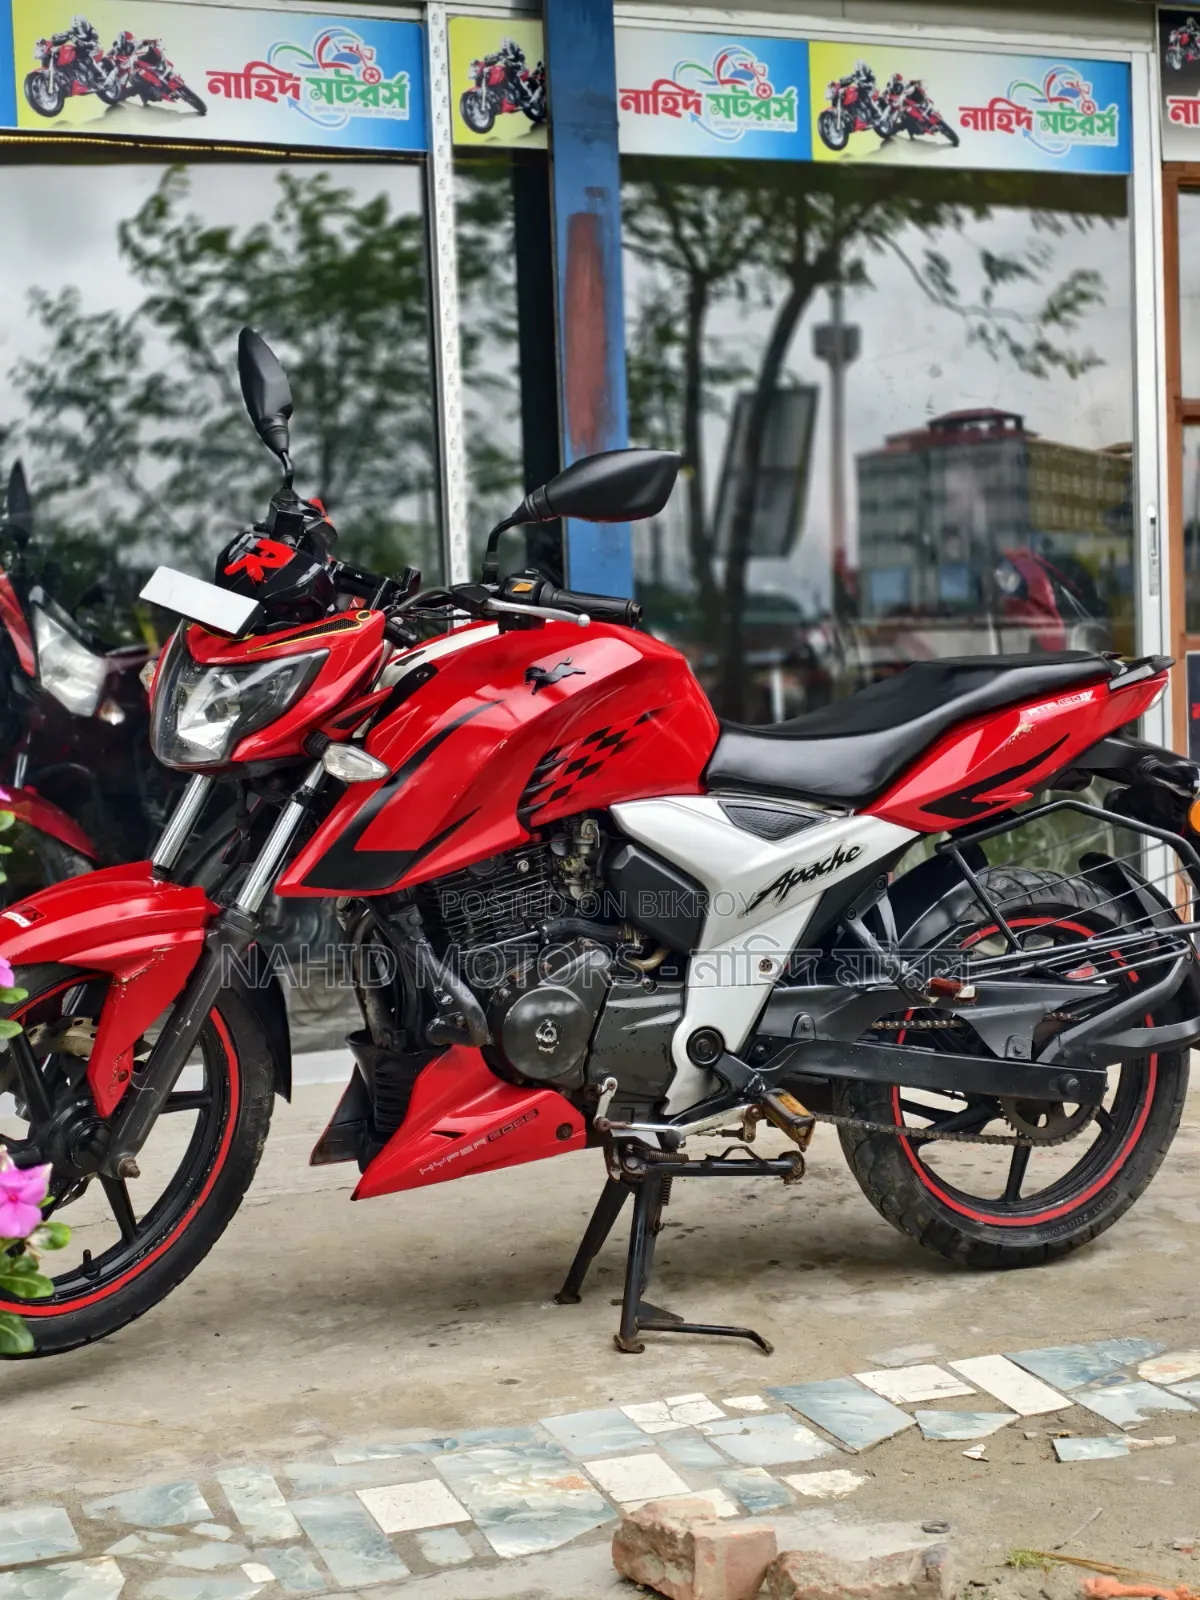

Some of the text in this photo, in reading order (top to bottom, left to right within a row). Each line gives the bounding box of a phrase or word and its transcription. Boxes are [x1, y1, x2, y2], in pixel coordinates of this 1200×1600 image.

[206, 61, 301, 103] নাহিদ
[618, 78, 703, 119] নাহিদ
[958, 97, 1034, 134] নাহিদ
[738, 843, 862, 917] Apache
[419, 1109, 538, 1175] HYPER EDGE
